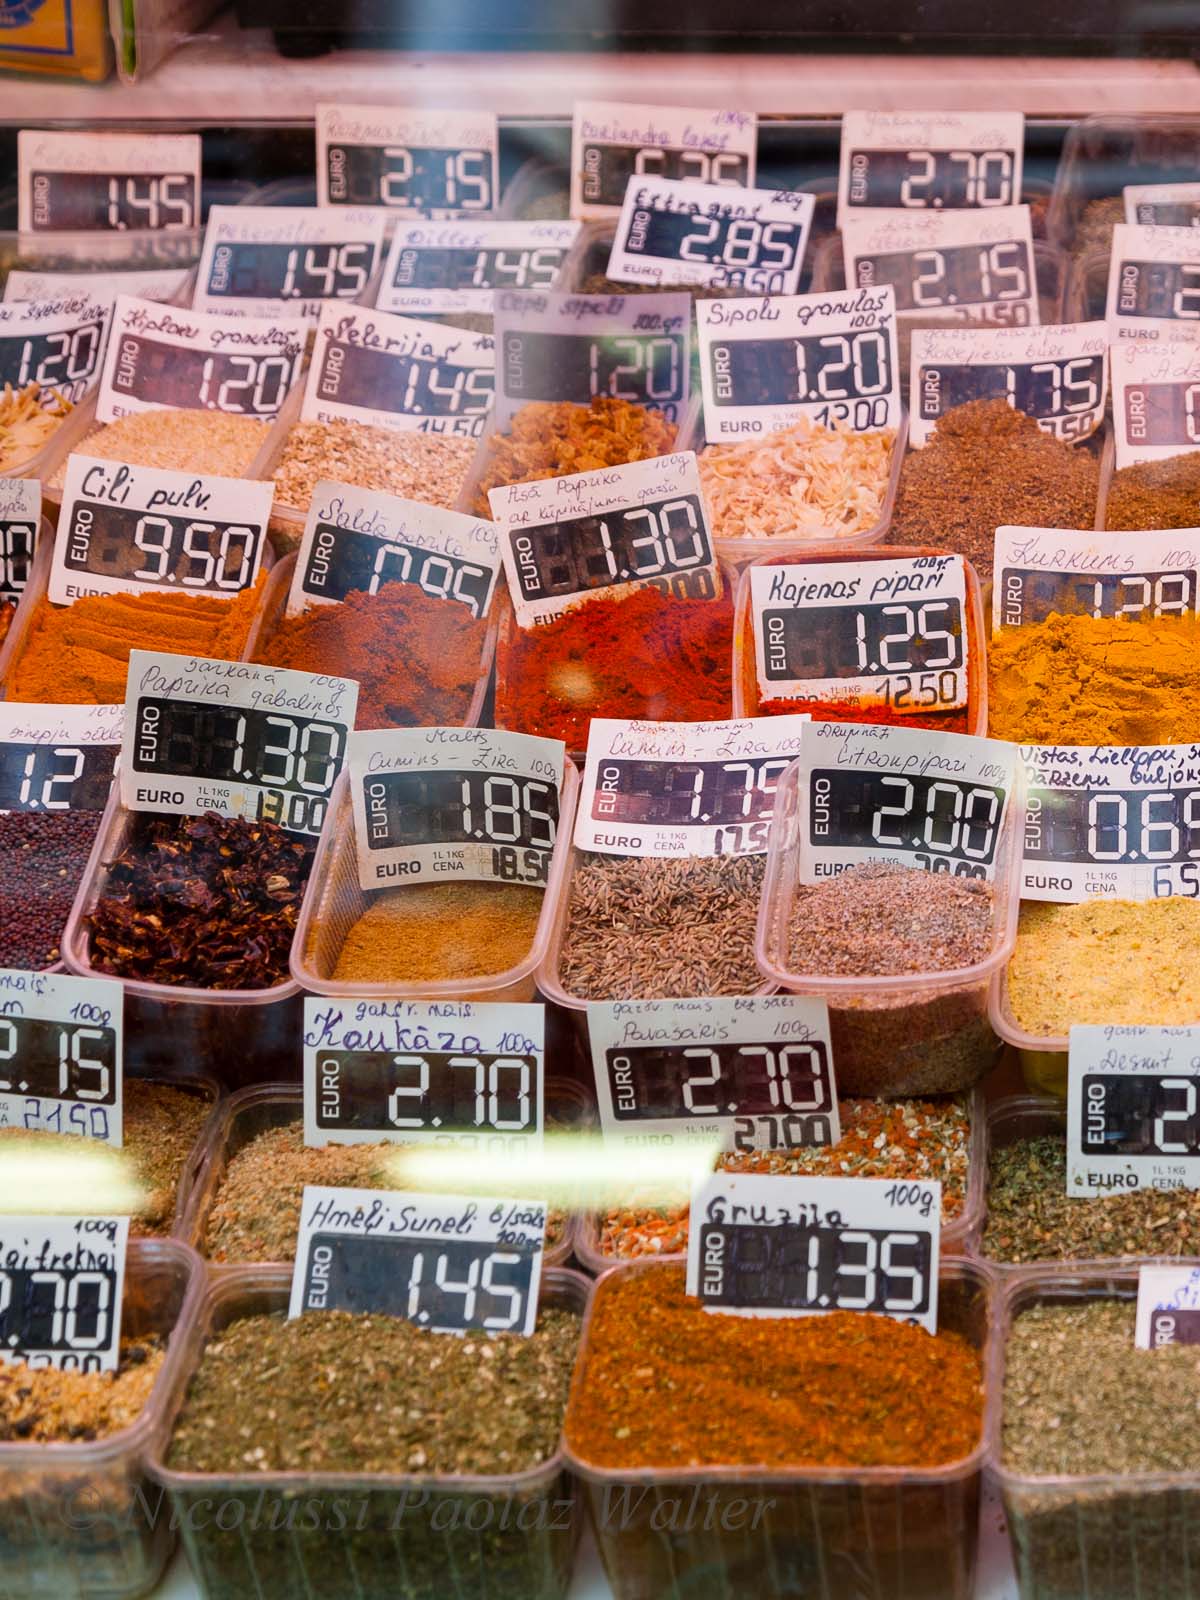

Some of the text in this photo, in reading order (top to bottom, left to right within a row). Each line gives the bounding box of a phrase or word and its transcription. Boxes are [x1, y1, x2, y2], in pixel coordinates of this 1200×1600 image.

[34, 176, 52, 225] EURO
[381, 148, 491, 210] 2.15
[584, 149, 600, 200] EURO
[851, 155, 869, 202] EURO
[902, 151, 1011, 207] 2.70
[107, 175, 192, 231] 1.45
[629, 211, 650, 250] EURO
[474, 250, 562, 289] 1.45
[679, 215, 794, 269] 2.85
[282, 244, 368, 297] 1.45
[912, 243, 1026, 306] 2.15
[1121, 266, 1139, 310] EURO
[18, 326, 100, 387] 1.20
[1119, 328, 1159, 340] EURO
[117, 341, 140, 389] EURO
[199, 356, 291, 413] 1.20
[322, 347, 345, 395] EURO
[404, 363, 496, 415] 1.45
[590, 338, 678, 399] 1.20
[714, 347, 730, 399] EURO
[797, 332, 887, 401] 1.20
[720, 420, 762, 433] EURO
[1129, 391, 1147, 438] EURO
[71, 508, 94, 564] EURO
[134, 514, 252, 592] 9.50
[309, 532, 335, 586] EURO
[600, 500, 704, 579] 1.30
[516, 537, 540, 592] EURO
[768, 570, 945, 609] Kajenas pipari
[1006, 575, 1024, 626] EURO
[768, 616, 786, 671] EURO
[855, 602, 957, 673] 1.25
[875, 670, 959, 708] 12.50
[139, 706, 161, 763] EURO
[232, 714, 340, 792] 1.30
[136, 789, 184, 805] EURO
[196, 797, 228, 810] CENA
[369, 783, 389, 839] EURO
[462, 776, 556, 849] 1.85
[691, 760, 791, 823] 1.75
[814, 778, 831, 835] EURO
[872, 776, 999, 859] 2.00
[433, 862, 464, 871] CENA
[1025, 876, 1073, 891] EURO
[322, 1059, 340, 1118] EURO
[388, 1056, 530, 1130] 2.70
[613, 1056, 636, 1111] EURO
[682, 1044, 824, 1114] 2.70
[734, 1115, 832, 1153] 27.00
[1088, 1083, 1106, 1144] EURO
[1088, 1173, 1138, 1187] EURO
[408, 1252, 521, 1329] 1.45
[703, 1231, 724, 1297] EURO
[806, 1232, 924, 1310] 1.35
